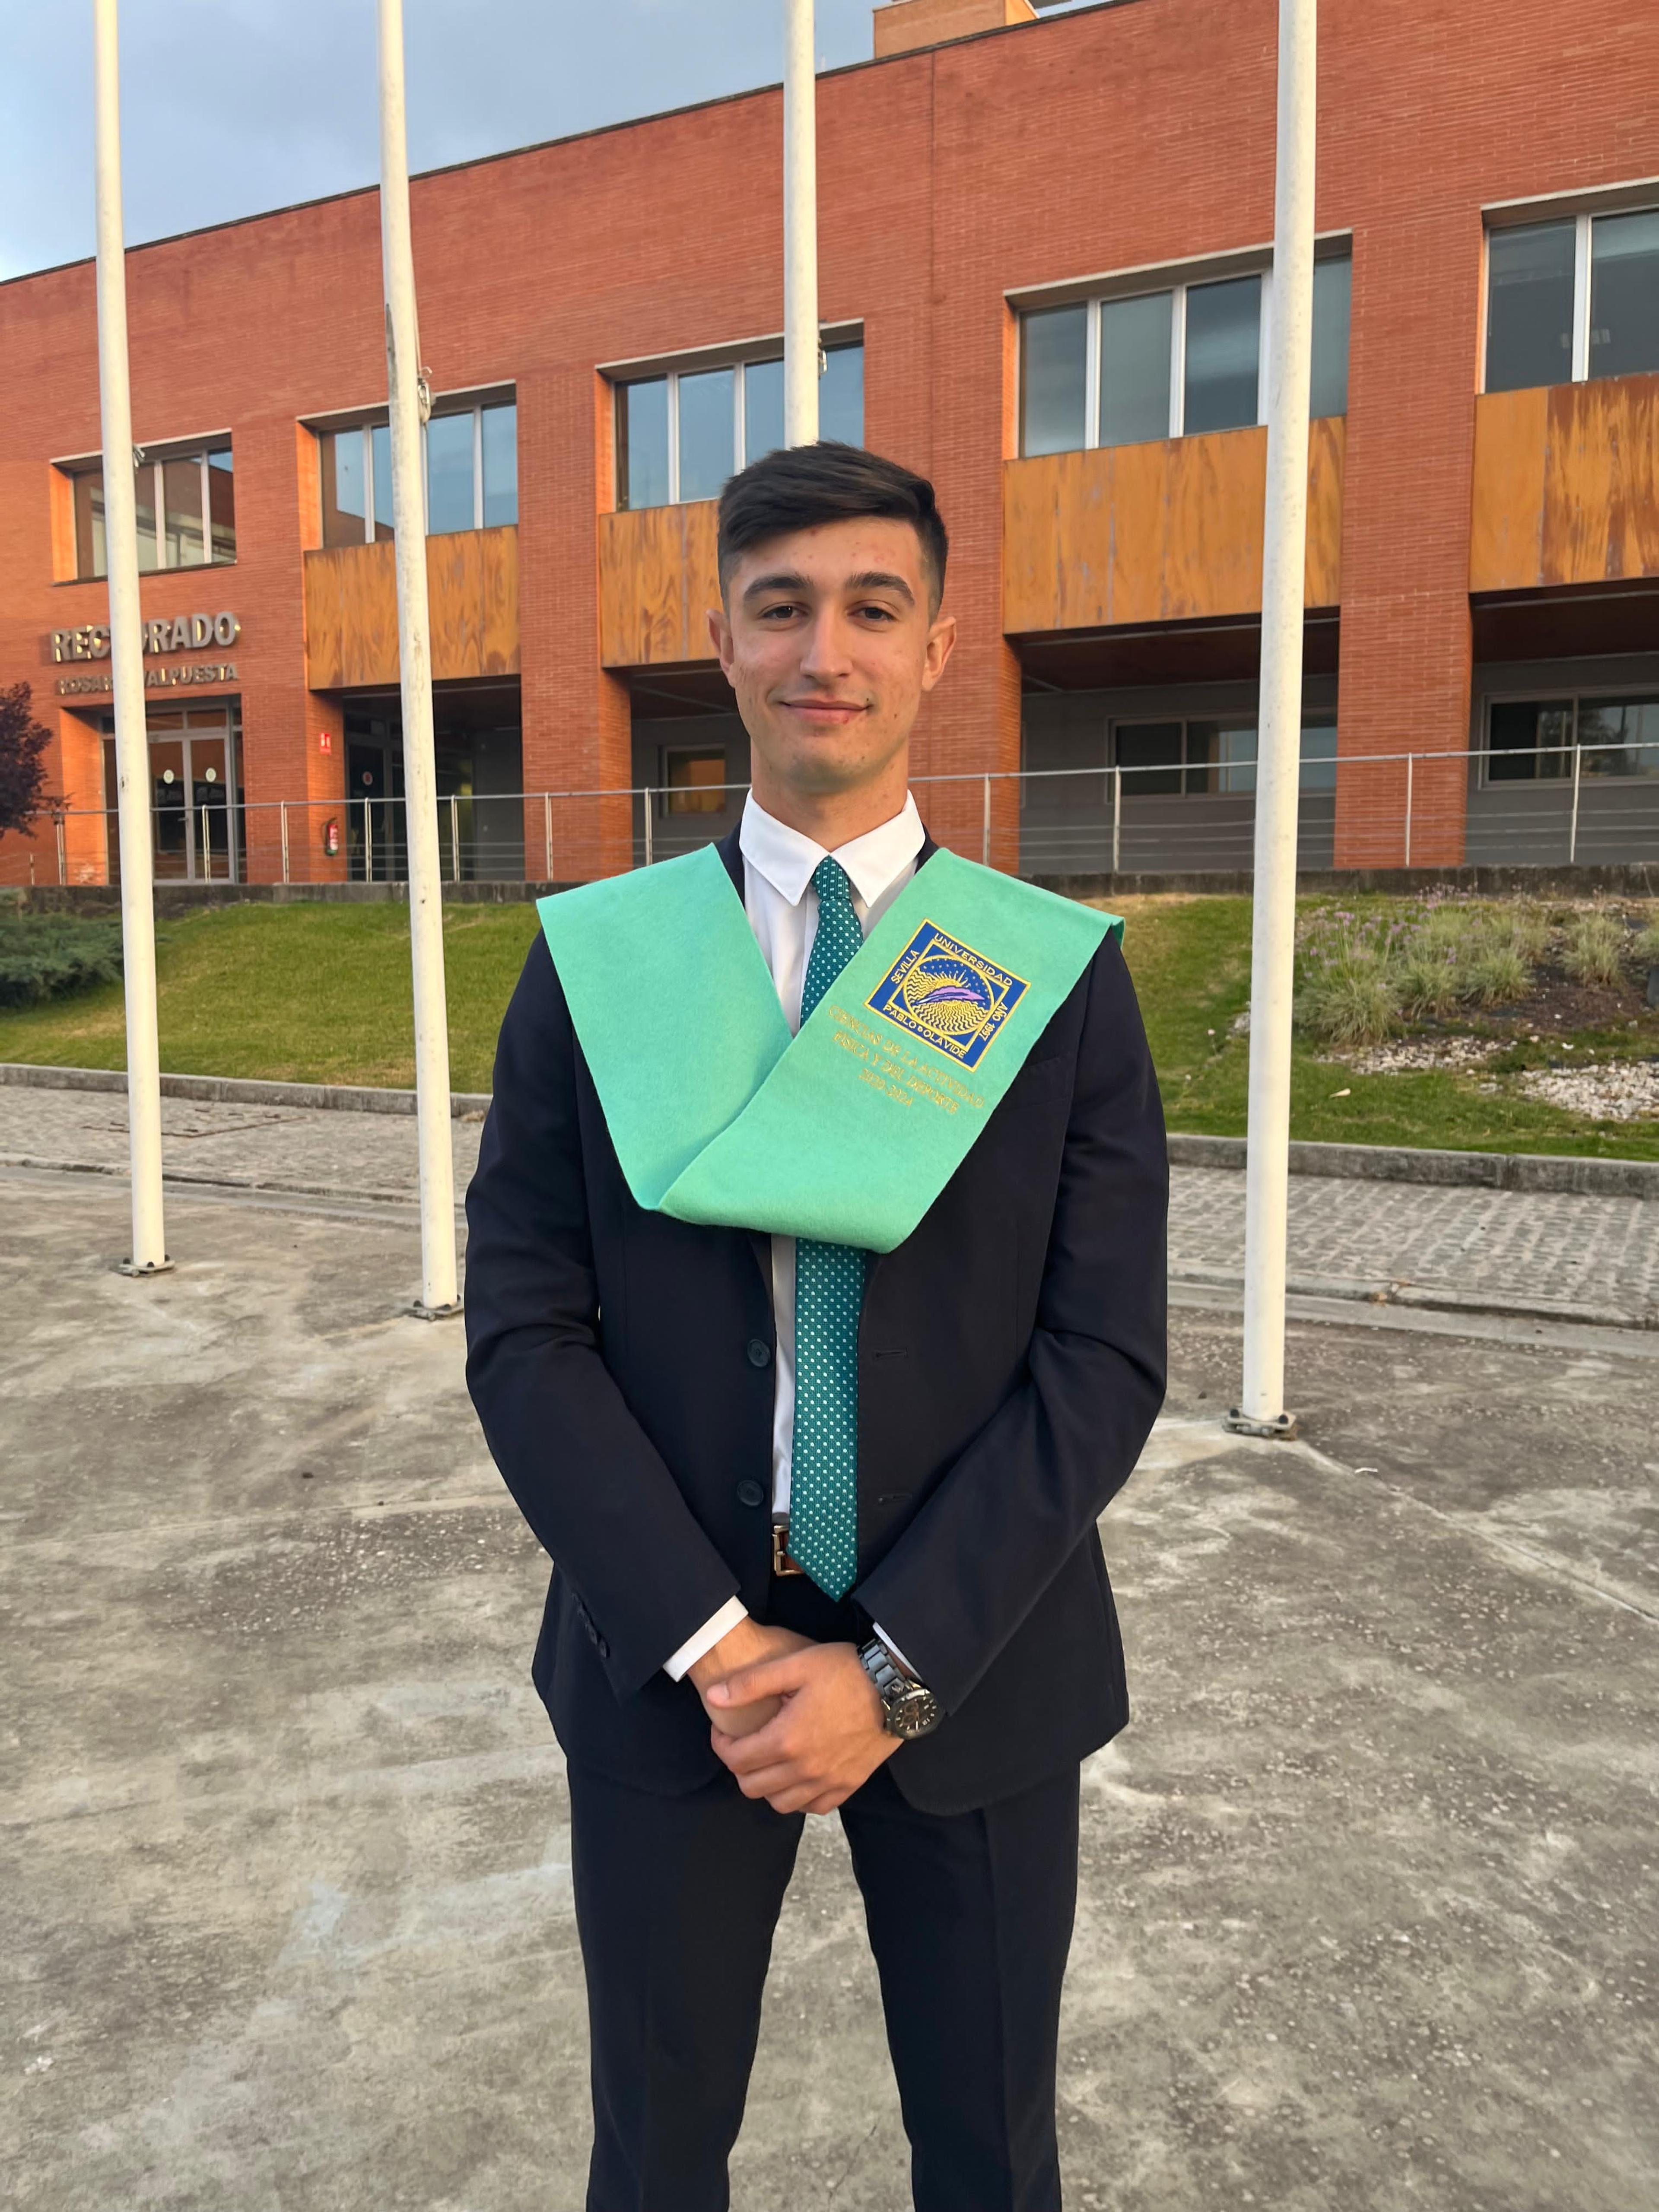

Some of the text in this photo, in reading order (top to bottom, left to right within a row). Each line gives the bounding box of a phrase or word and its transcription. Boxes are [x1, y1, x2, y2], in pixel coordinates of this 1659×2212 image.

[51, 611, 239, 663] RECRADO
[58, 674, 113, 695] ROSAR
[891, 950, 920, 985] SEVILLA
[933, 933, 1012, 986] UNIVERSIDAD
[883, 1005, 917, 1029] PABLO
[923, 1029, 967, 1058] OLAVIDE
[979, 1002, 1008, 1042] AÑO 1997
[829, 1005, 984, 1108] CIENCIAS DE LA ACTIVIDAD
[871, 1053, 882, 1066] Y
[881, 1060, 905, 1081] DEL
[906, 1076, 960, 1114] DEPORTE
